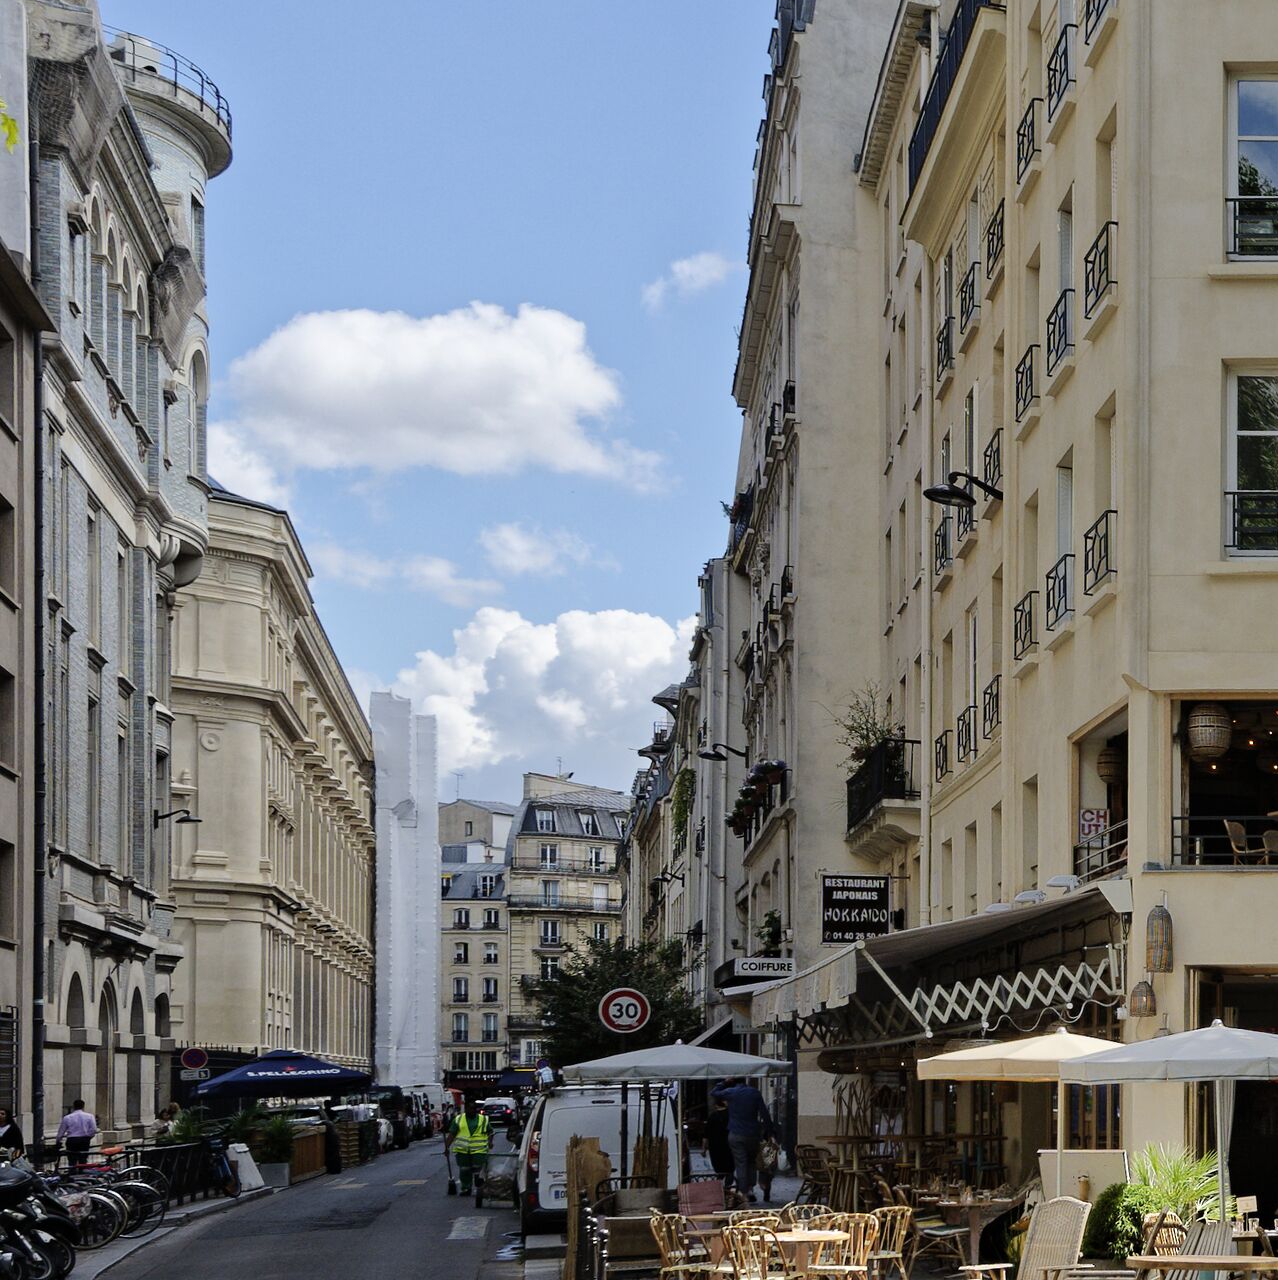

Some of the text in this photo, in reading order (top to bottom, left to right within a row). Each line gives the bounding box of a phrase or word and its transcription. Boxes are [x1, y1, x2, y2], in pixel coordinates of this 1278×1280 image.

[1082, 810, 1107, 824] CH
[825, 878, 886, 888] RESTAURANT
[832, 891, 878, 900] JAPONAIS
[824, 907, 888, 923] HOKKAIDO
[832, 931, 842, 940] 01
[843, 931, 854, 940] 40
[855, 931, 865, 940] 26
[741, 962, 793, 971] COIFFURE
[612, 1002, 638, 1018] 30
[247, 1068, 341, 1077] S.PELLEGRINO
